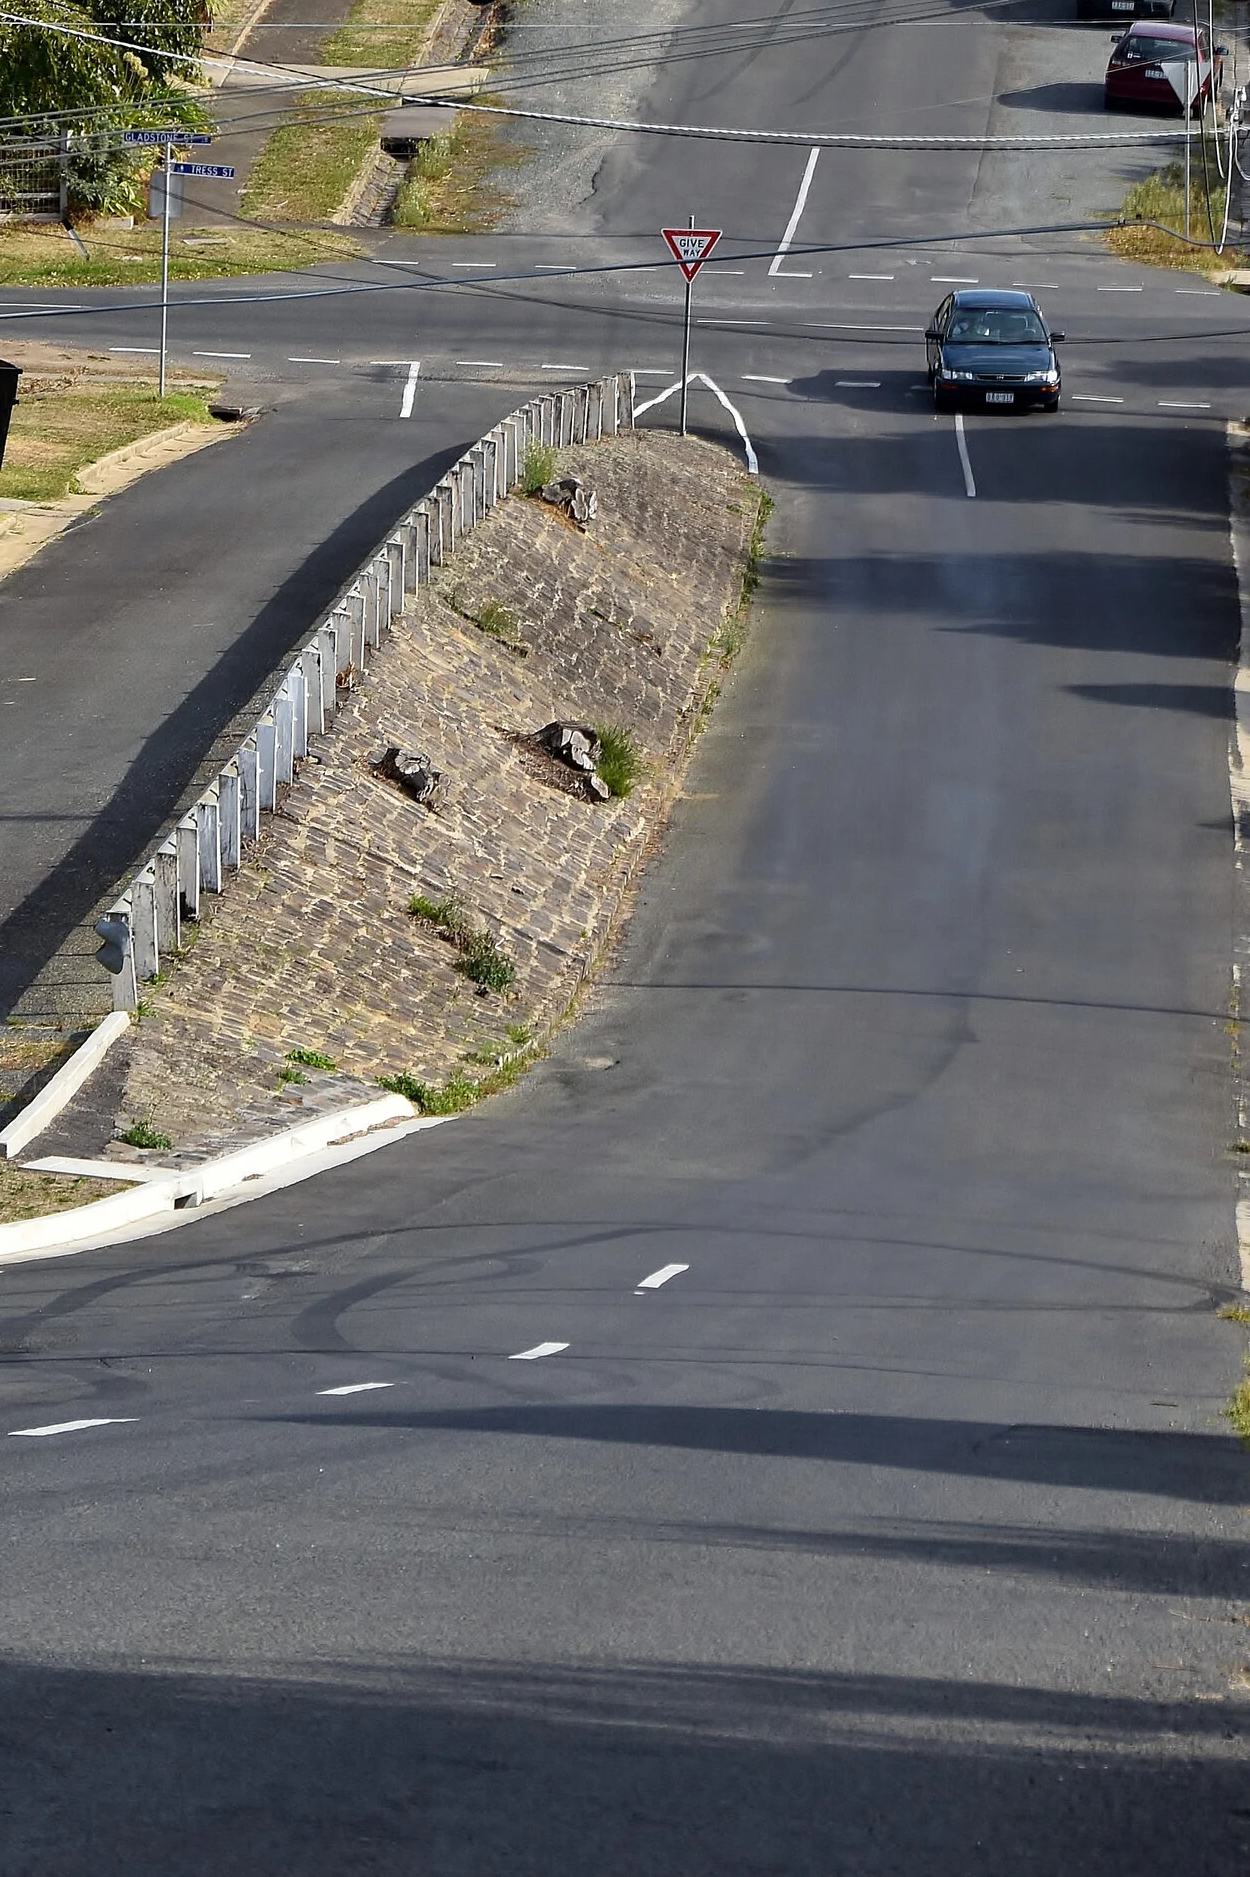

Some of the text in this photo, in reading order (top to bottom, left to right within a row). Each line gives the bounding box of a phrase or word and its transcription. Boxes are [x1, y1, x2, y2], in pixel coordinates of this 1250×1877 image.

[125, 132, 195, 143] GLADSTONE ST
[191, 165, 233, 177] TRESS ST
[679, 239, 705, 248] GIVE
